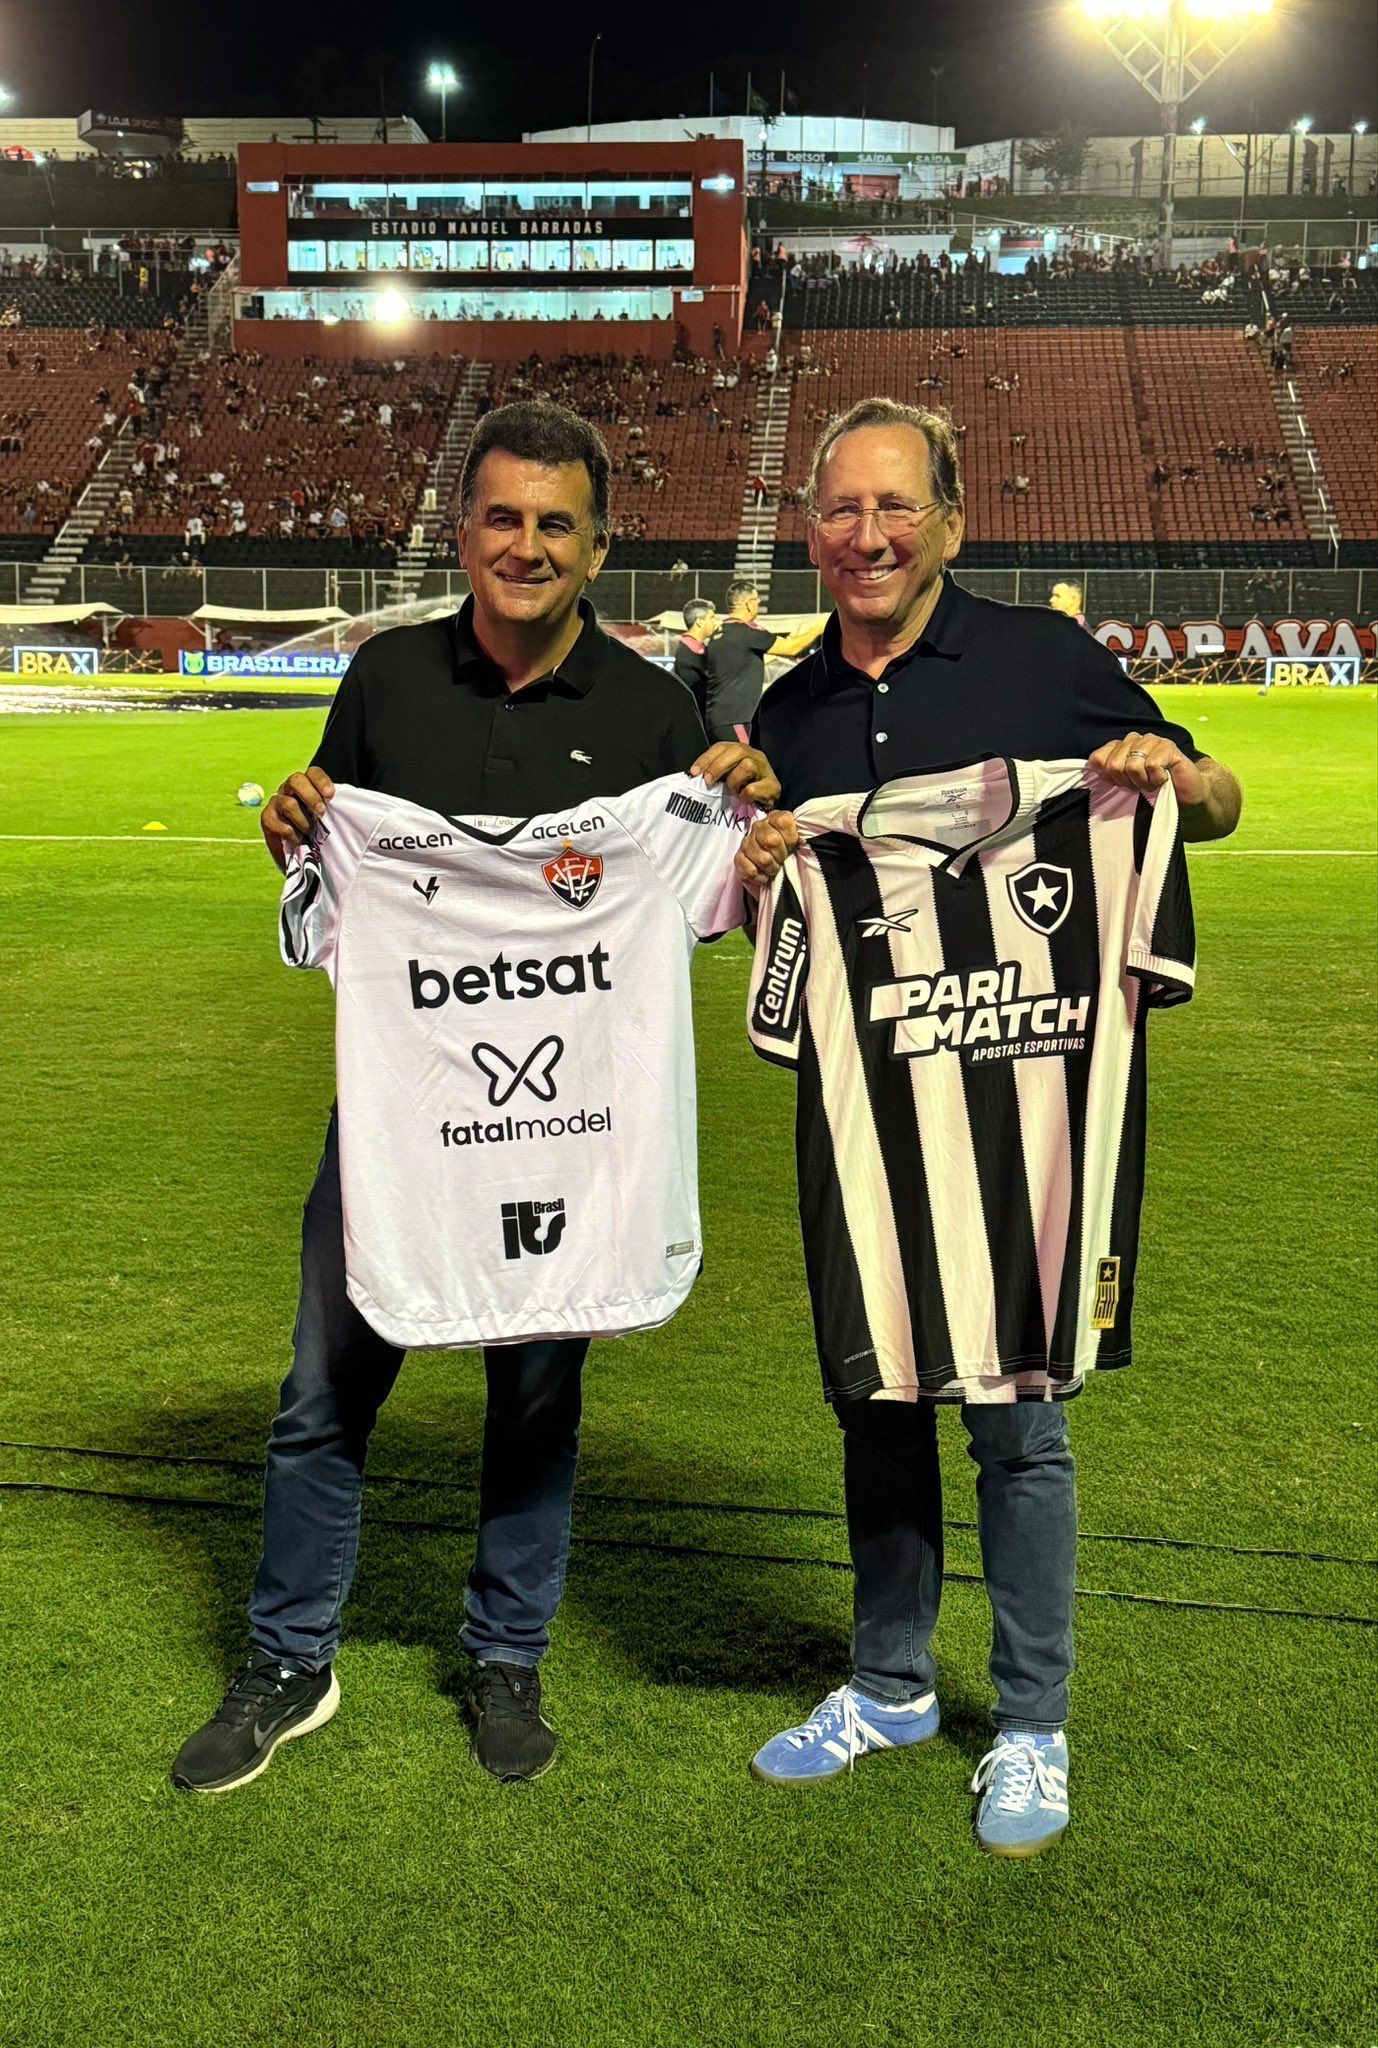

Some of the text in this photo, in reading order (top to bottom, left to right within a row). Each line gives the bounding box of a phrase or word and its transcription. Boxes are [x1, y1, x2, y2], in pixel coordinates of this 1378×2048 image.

[747, 151, 776, 162] etst
[786, 152, 826, 162] betsat
[371, 221, 603, 235] ESTADIO MANOEL BARRADAS
[1092, 620, 1378, 659] CARAVA
[22, 652, 90, 675] BRAX
[207, 653, 350, 674] BRASILEIRÃ
[1274, 662, 1351, 686] BRAX
[531, 815, 605, 840] acelen
[378, 833, 453, 850] acelen
[408, 941, 612, 1010] betsat
[759, 918, 803, 1025] Centrum
[870, 967, 1016, 1022] PARI
[894, 996, 1090, 1054] MATCH
[972, 1037, 1085, 1062] APOSTAS ESPORTIVAS
[440, 1107, 612, 1147] fatalmodel
[533, 1198, 565, 1215] Brasil
